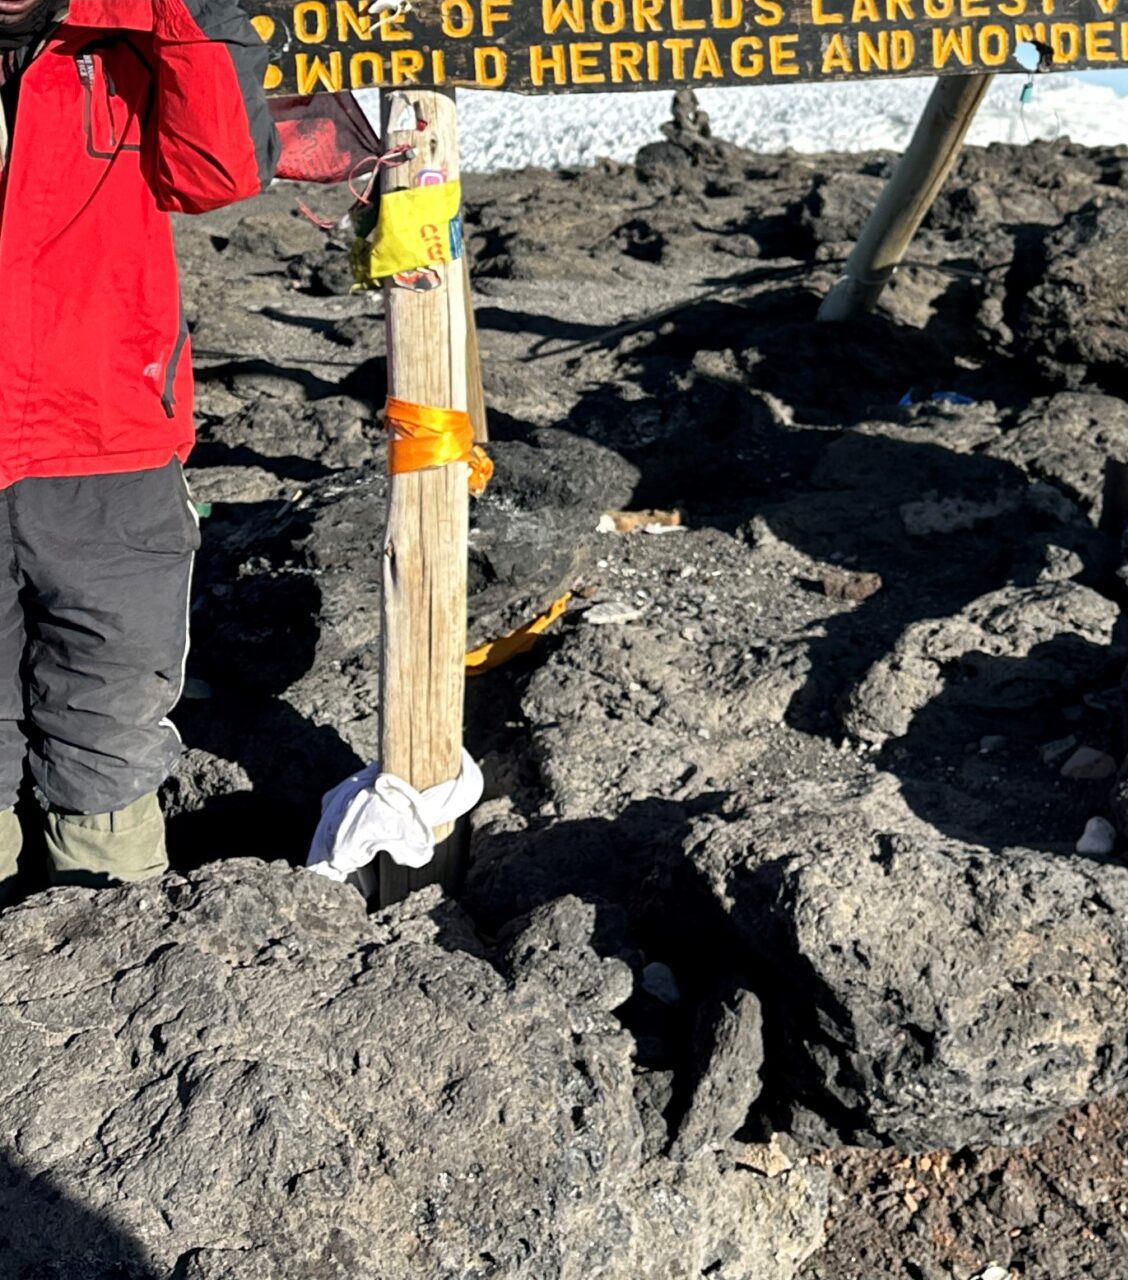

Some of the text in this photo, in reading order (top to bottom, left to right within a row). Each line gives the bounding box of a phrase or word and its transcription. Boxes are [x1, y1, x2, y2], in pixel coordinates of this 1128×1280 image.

[294, 46, 508, 95] WORLD
[530, 35, 800, 85] HERITAGE
[822, 30, 915, 75] AND
